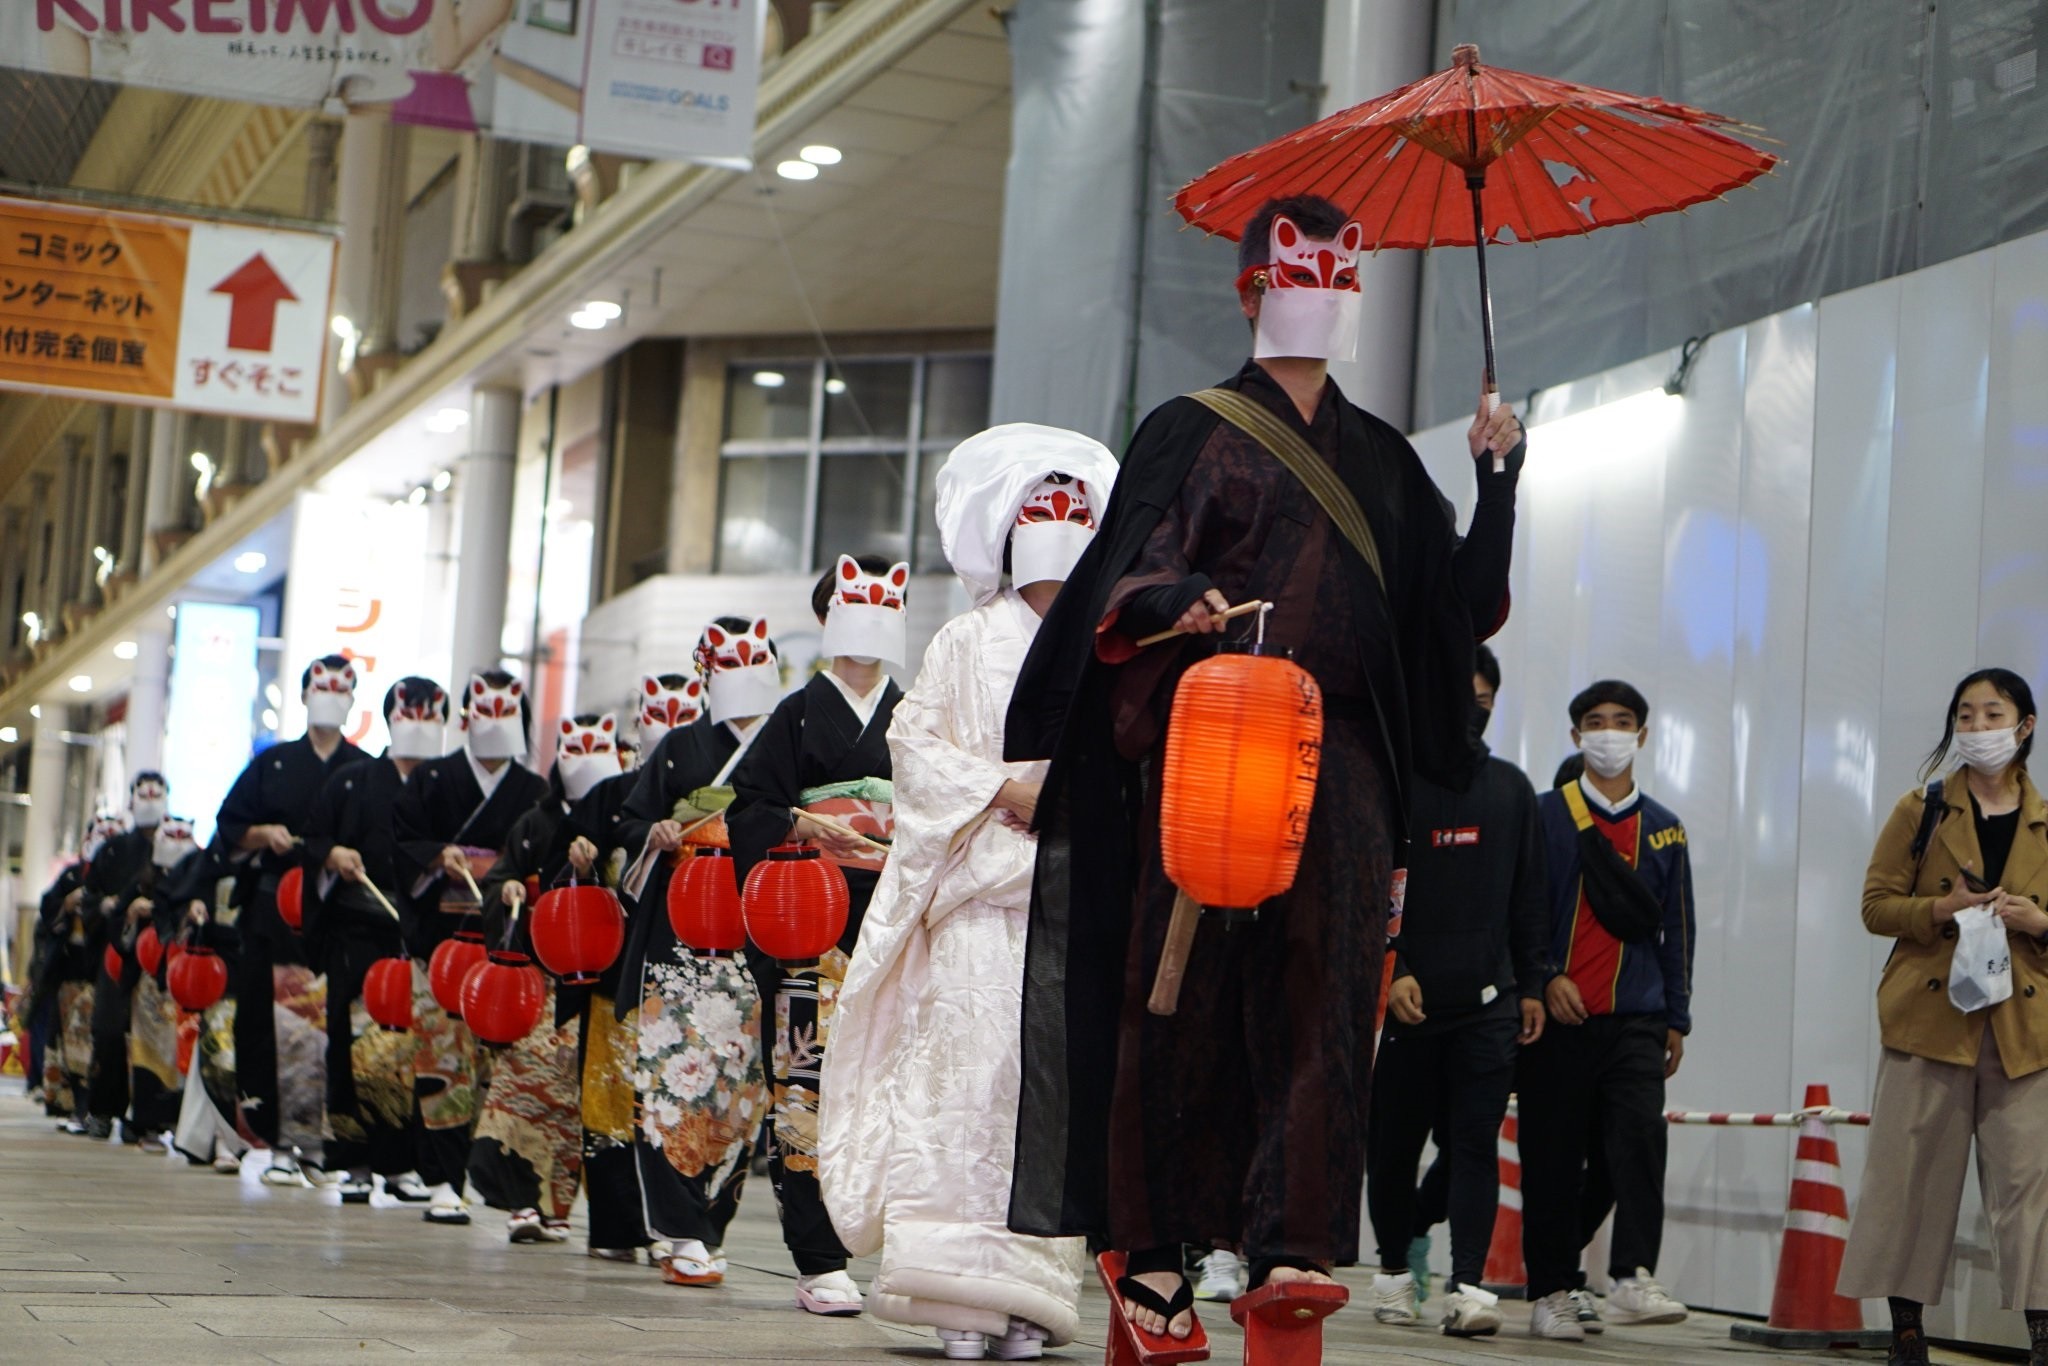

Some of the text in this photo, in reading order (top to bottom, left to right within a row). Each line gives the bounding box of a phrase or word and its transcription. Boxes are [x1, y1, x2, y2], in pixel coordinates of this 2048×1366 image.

[18, 231, 123, 266] コミック
[0, 326, 147, 367] 付完全個室
[191, 358, 303, 396] すぐそこ
